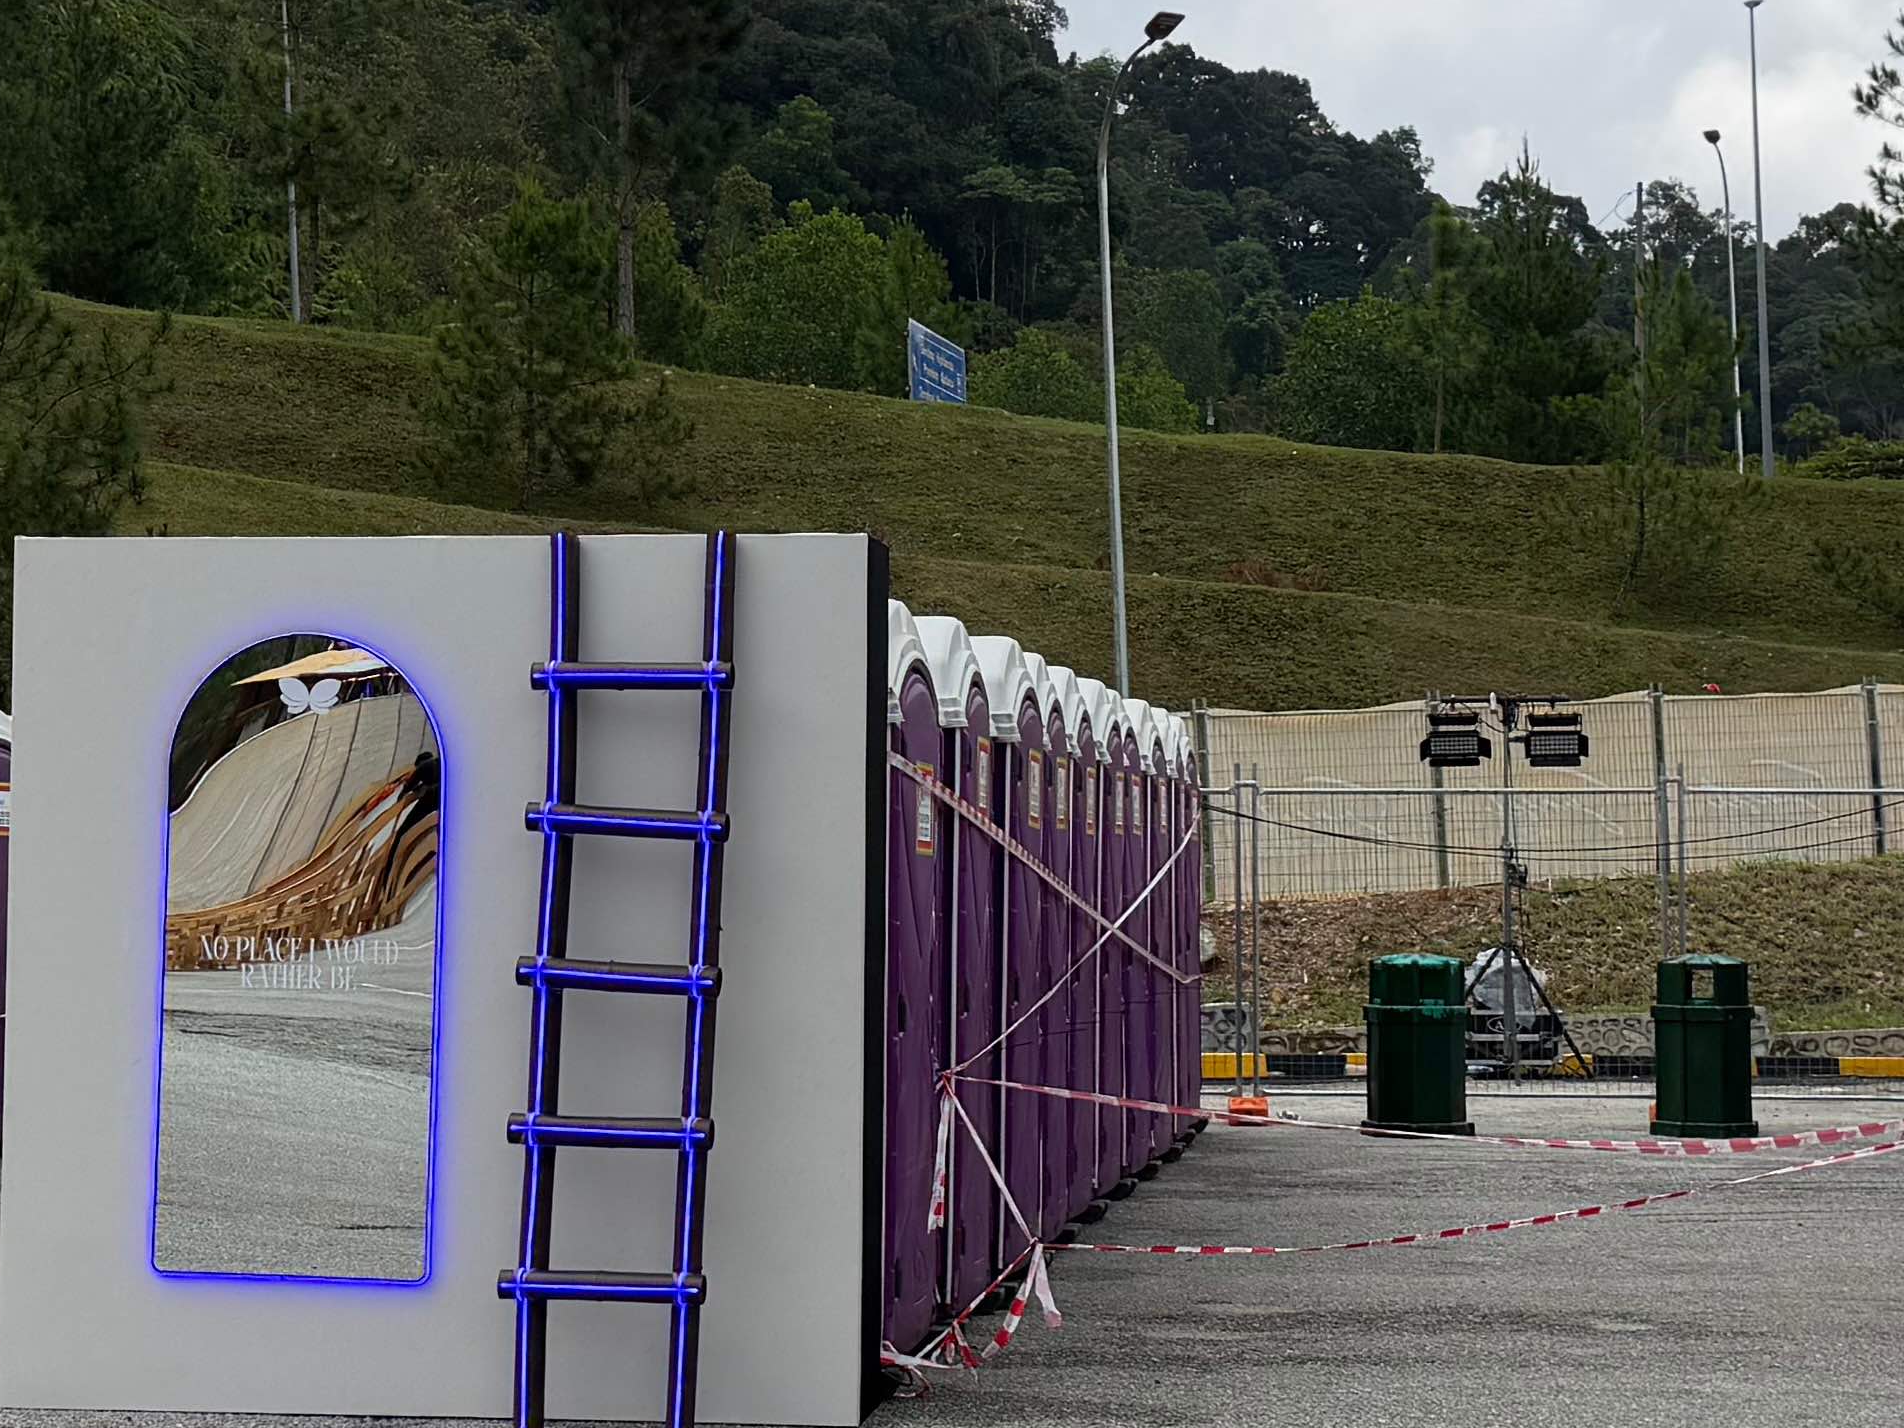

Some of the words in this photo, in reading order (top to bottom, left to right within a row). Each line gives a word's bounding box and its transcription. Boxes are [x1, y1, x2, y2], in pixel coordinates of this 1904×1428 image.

[200, 935, 229, 961] NO
[237, 936, 303, 963] PLACE
[325, 938, 399, 965] WOULD
[241, 963, 322, 989] RATHER
